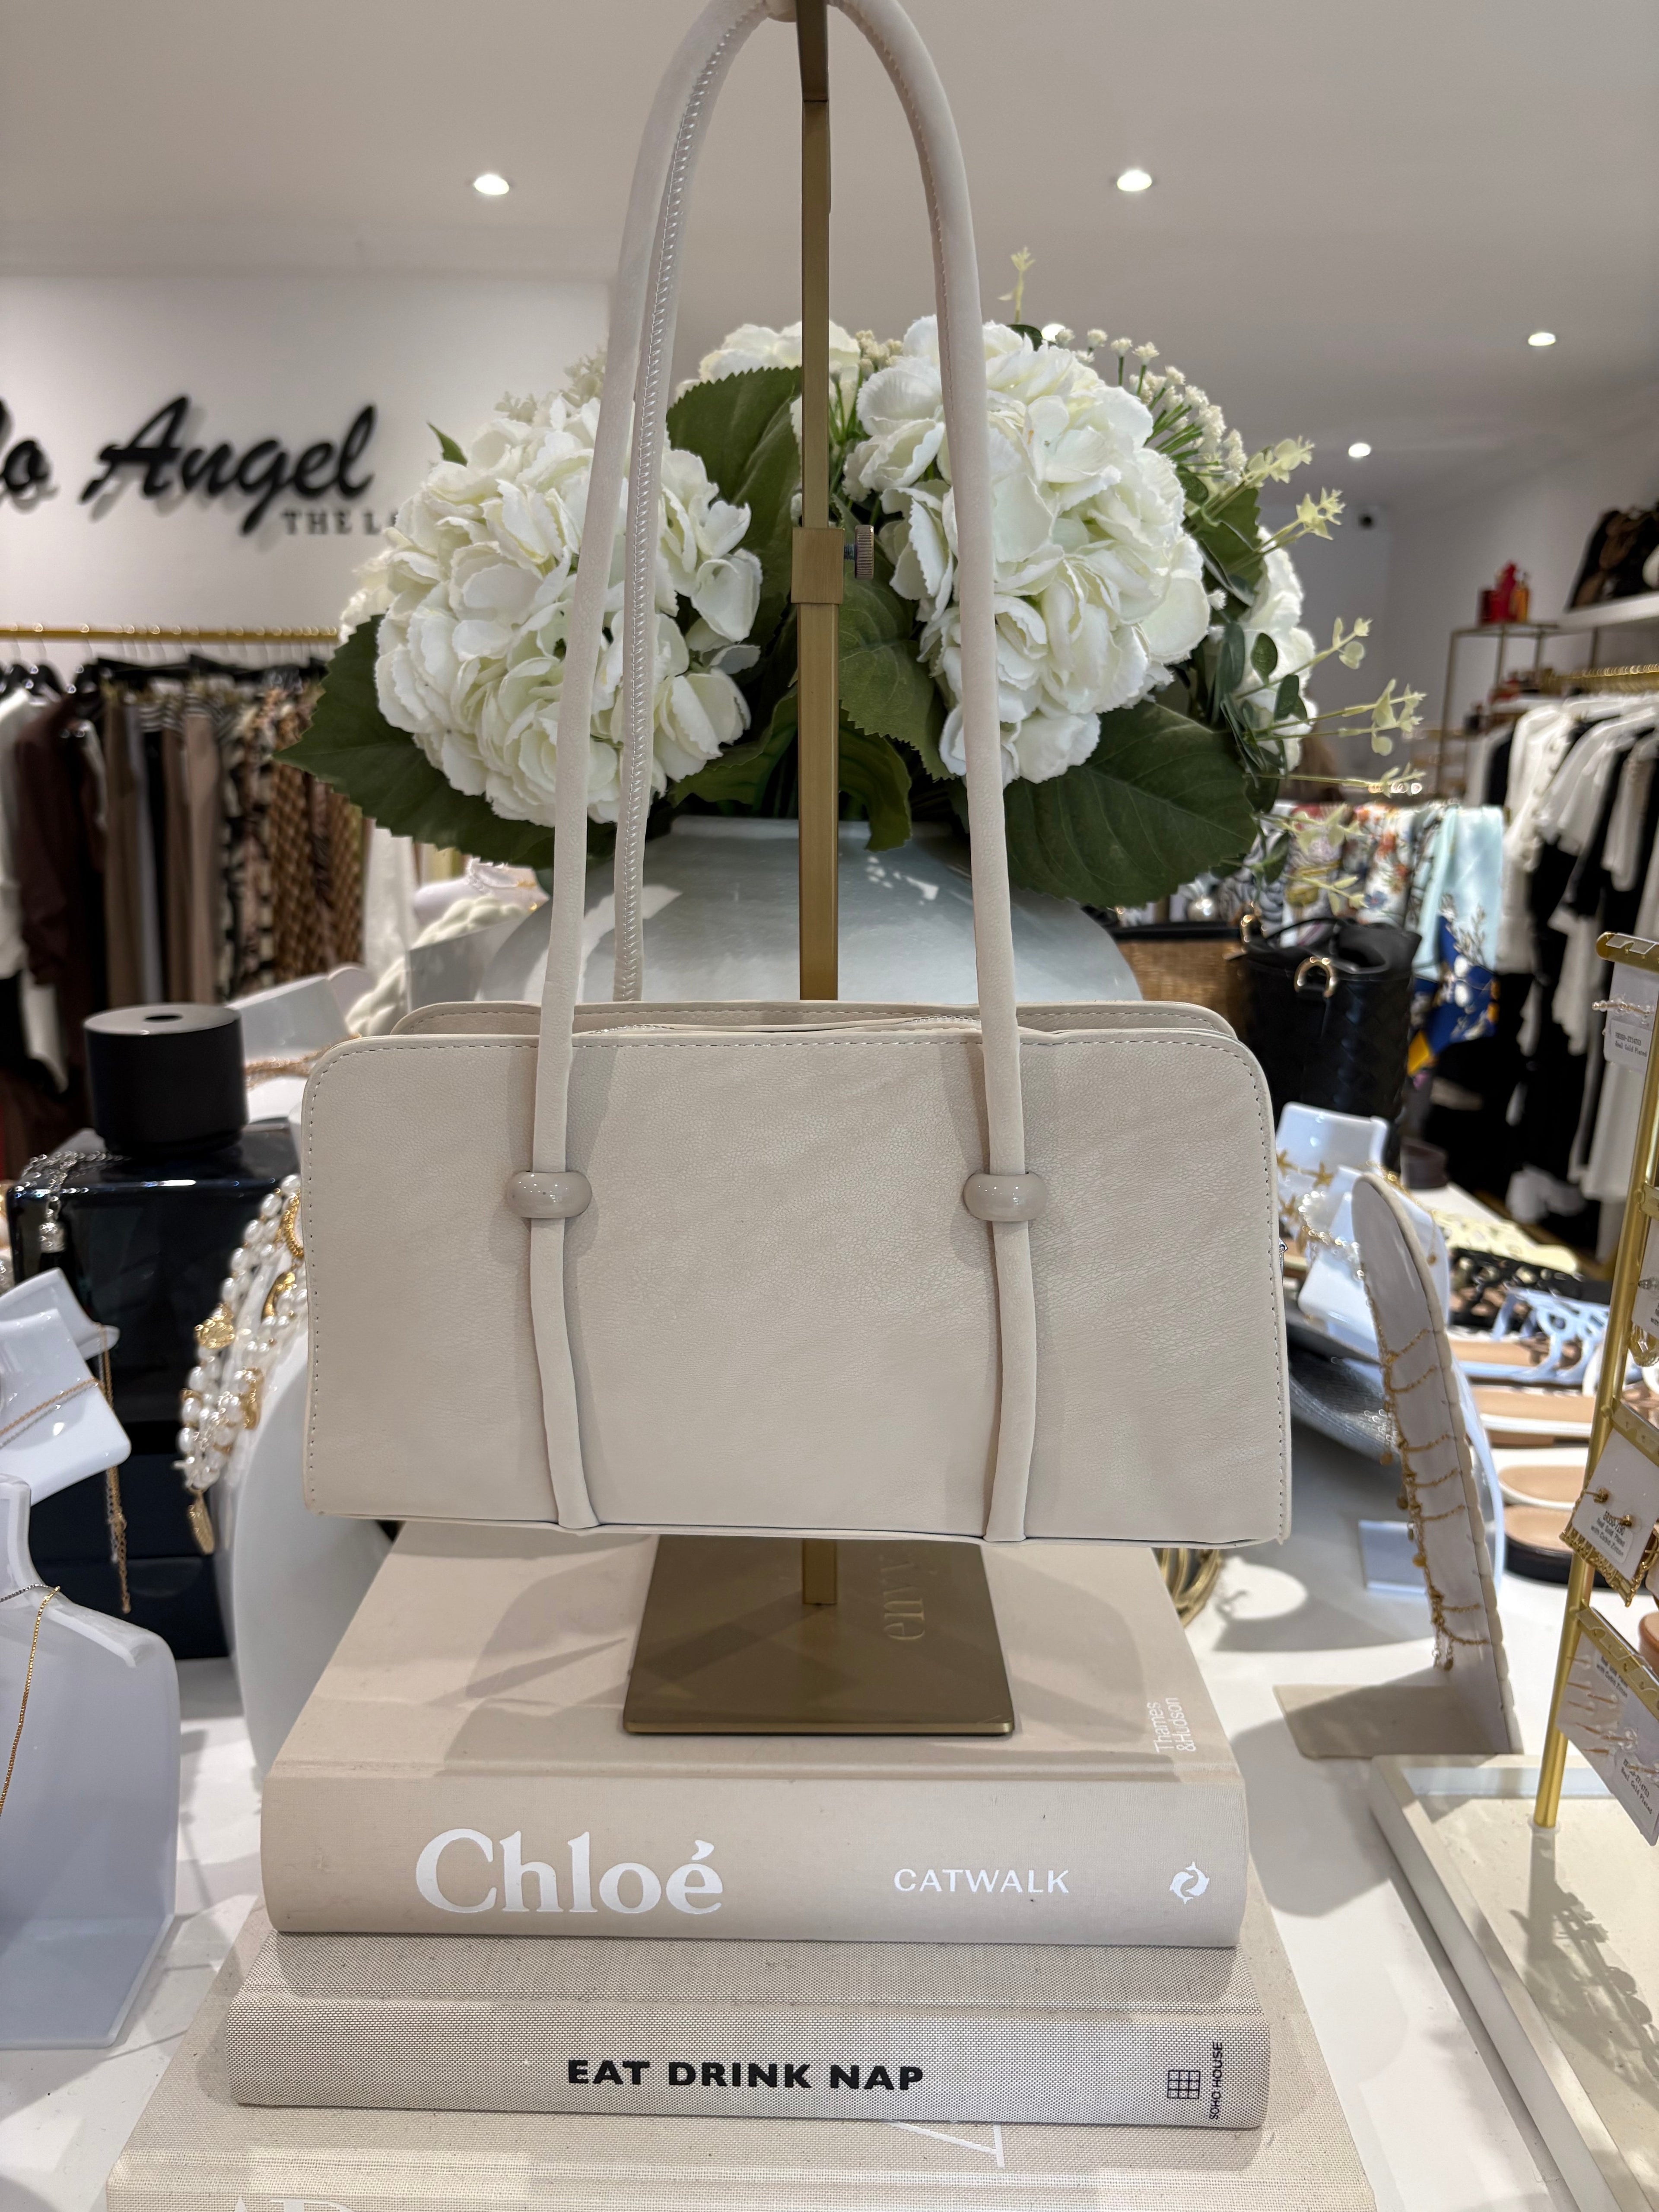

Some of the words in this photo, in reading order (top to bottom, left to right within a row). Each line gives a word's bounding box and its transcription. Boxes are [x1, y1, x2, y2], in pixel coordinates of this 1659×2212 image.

[79, 394, 375, 536] Angel
[282, 509, 352, 535] THE
[1147, 1701, 1175, 1753] Thames
[416, 1828, 723, 1914] Chloé
[893, 1868, 1069, 1893] CATWALK
[568, 2059, 650, 2085] EAT
[668, 2061, 812, 2088] DRINK
[830, 2064, 923, 2090] NAP
[1211, 2041, 1223, 2088] HOUSE
[1210, 2091, 1221, 2120] SOHO
